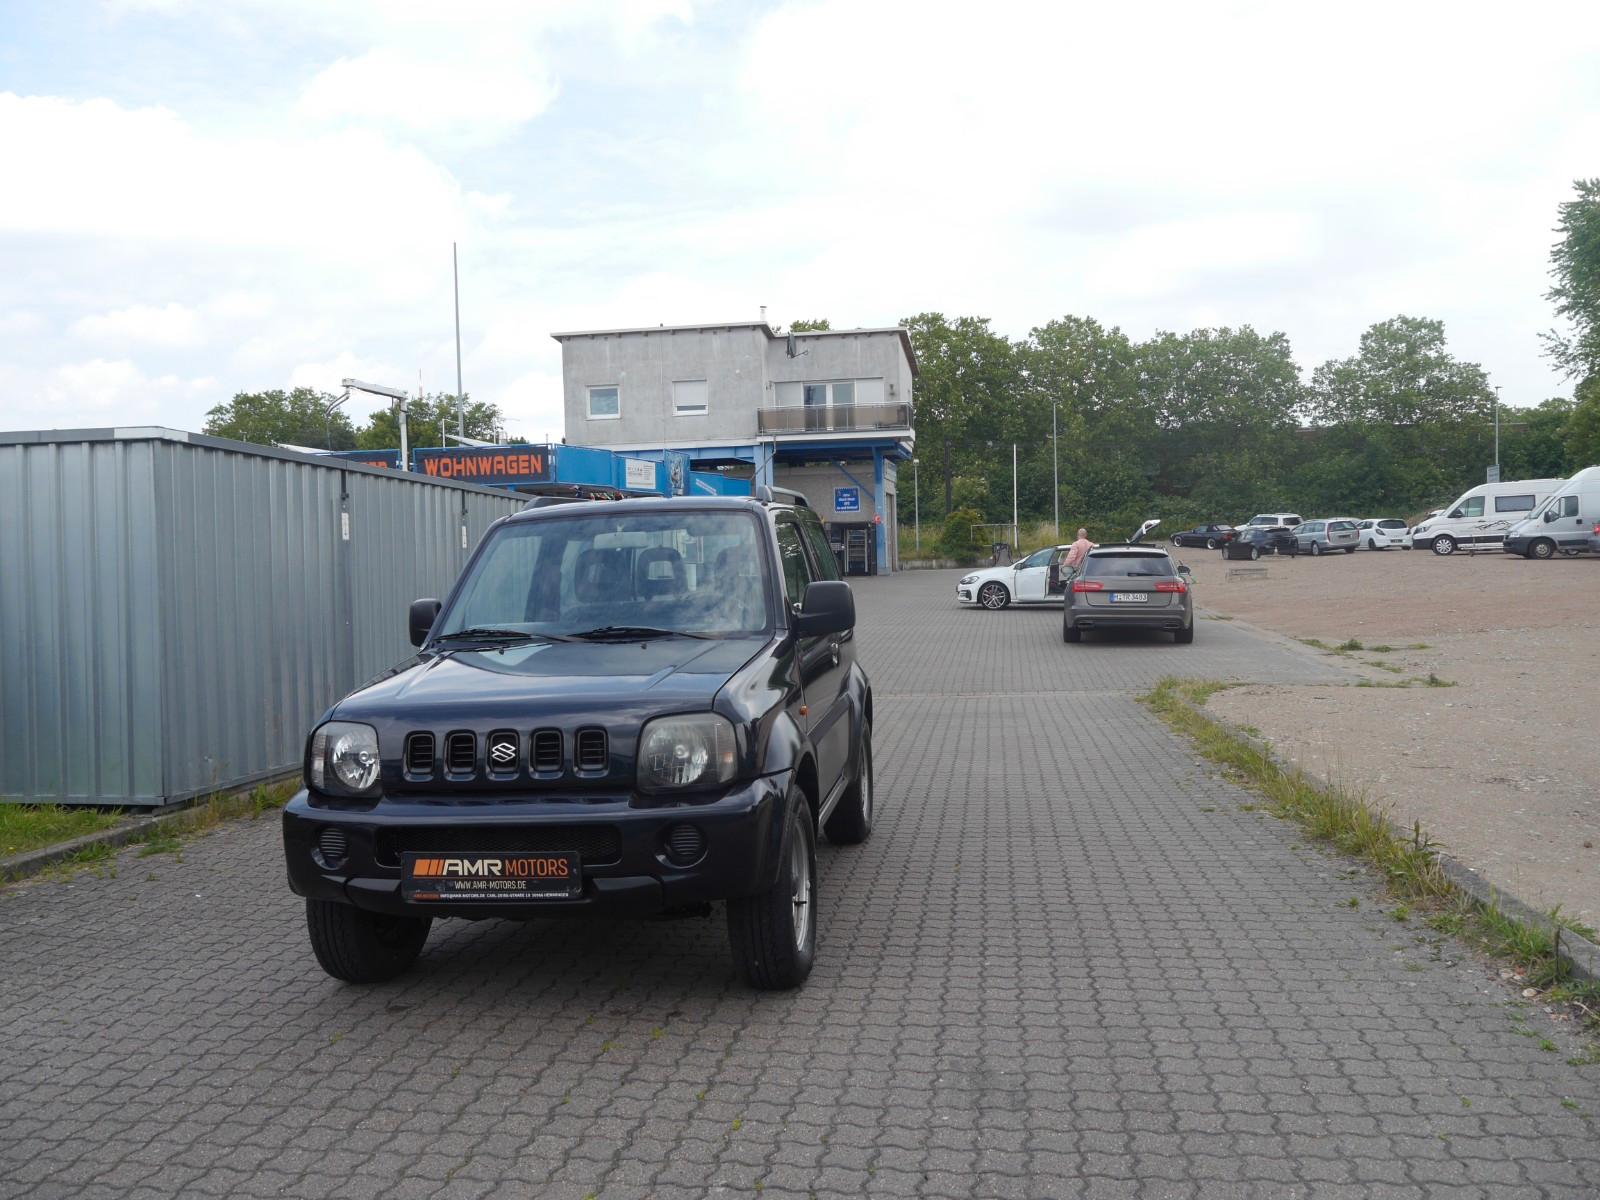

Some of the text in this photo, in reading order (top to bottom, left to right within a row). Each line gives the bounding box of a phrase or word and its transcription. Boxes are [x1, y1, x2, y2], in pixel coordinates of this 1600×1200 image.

[424, 454, 542, 478] WOHNWAGEN
[442, 859, 569, 876] AMR MOTORS
[454, 880, 527, 890] WWW.AMR-MOTORS.DE
